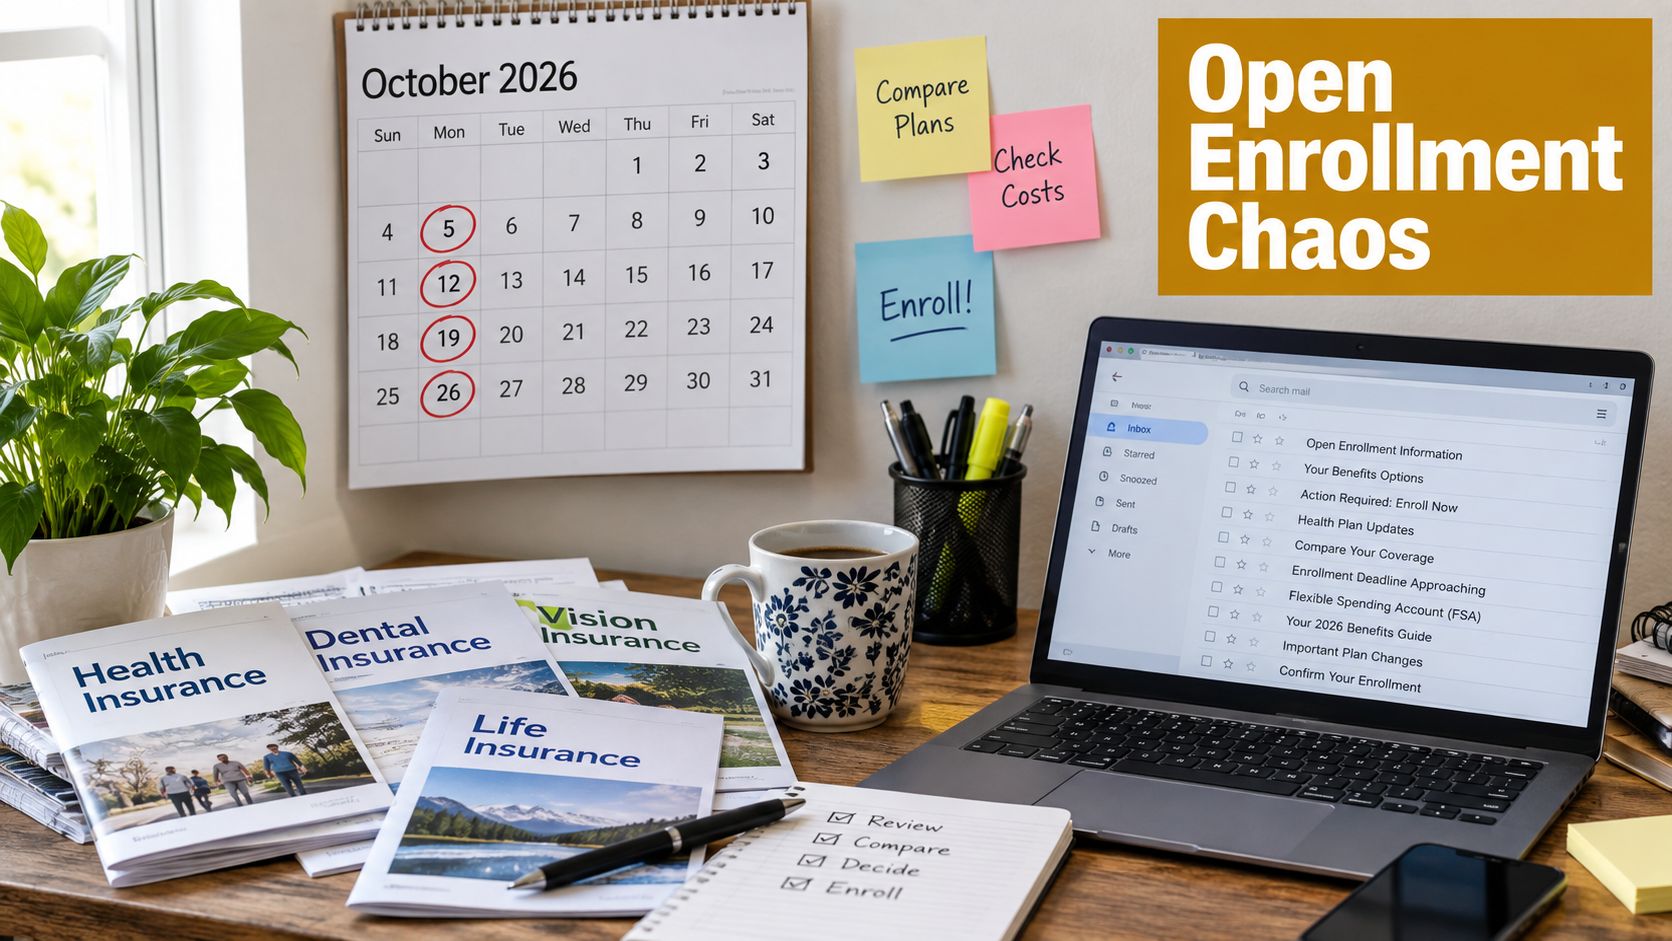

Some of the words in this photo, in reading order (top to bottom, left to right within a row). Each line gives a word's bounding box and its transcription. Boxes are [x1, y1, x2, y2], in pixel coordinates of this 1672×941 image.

[361, 64, 490, 99] October
[499, 61, 578, 93] 2026
[876, 80, 969, 107] Compare
[374, 128, 400, 142] Sun
[434, 125, 464, 139] Mon
[498, 122, 524, 136] Tue
[558, 118, 590, 133] Wed
[623, 117, 650, 130] Thu
[691, 114, 708, 128] Fri
[752, 112, 774, 126] Sat
[894, 112, 954, 138] Plans
[633, 157, 640, 174] 1
[694, 154, 706, 172] 2
[758, 152, 770, 169] 3
[993, 141, 1062, 173] Check
[1001, 180, 1064, 207] Costs
[381, 224, 394, 240] 4
[443, 220, 455, 237] 5
[506, 217, 518, 234] 6
[568, 214, 580, 231] 7
[631, 212, 643, 229] 8
[694, 209, 706, 226] 9
[752, 207, 775, 224] 10
[377, 279, 396, 296] 11
[438, 275, 461, 292] 12
[501, 272, 523, 289] 13
[563, 269, 586, 286] 14
[626, 266, 648, 283] 15
[688, 264, 711, 281] 16
[751, 262, 774, 279] 17
[880, 280, 971, 321] Enroll!
[377, 333, 399, 350] 18
[438, 329, 460, 347] 19
[499, 326, 524, 343] 20
[562, 323, 583, 340] 21
[624, 320, 648, 337] 22
[687, 318, 711, 335] 23
[750, 316, 774, 333] 24
[376, 388, 400, 405] 25
[436, 384, 461, 401] 26
[499, 380, 523, 397] 27
[562, 377, 586, 394] 28
[624, 374, 648, 391] 29
[686, 372, 711, 389] 30
[749, 371, 770, 387] 31
[1259, 383, 1289, 394] Search
[1292, 384, 1311, 397] mail
[1127, 423, 1151, 433] Inbox
[1123, 448, 1155, 459] Starred
[1306, 437, 1335, 450] Open
[1338, 440, 1396, 455] Enrollment
[1399, 445, 1462, 460] Information
[1119, 473, 1157, 485] Snoozed
[1304, 463, 1329, 474] Your
[1331, 465, 1376, 479] Benefits
[1380, 469, 1423, 483] Options
[1115, 498, 1135, 508] Sent
[1300, 489, 1335, 501] Action
[1339, 492, 1391, 507] Required:
[1395, 497, 1428, 510] Enroll
[1431, 501, 1458, 512] Now
[1111, 523, 1137, 534] Drafts
[1297, 514, 1334, 527] Health
[1337, 518, 1362, 530] Plan
[1366, 521, 1414, 535] Updates
[1108, 548, 1131, 559] More
[1294, 539, 1346, 554] Compare
[1350, 545, 1375, 557] Your
[1378, 549, 1434, 565] Coverage
[1291, 565, 1353, 581] Enrollment
[1356, 572, 1407, 587] Deadline
[1410, 578, 1485, 598] Approaching
[536, 605, 658, 632] Vision
[1288, 589, 1333, 604] Flexible
[1336, 596, 1391, 614] Spending
[1394, 602, 1443, 617] Account
[1447, 608, 1480, 624] (FSA)
[305, 615, 430, 650] Dental
[541, 627, 701, 653] Insurance
[1286, 615, 1311, 627] Your
[1314, 618, 1344, 631] 2026
[1347, 622, 1393, 637] Benefits
[1397, 628, 1432, 642] Guide
[316, 633, 492, 672] Insurance
[1282, 641, 1338, 656] Important
[1342, 647, 1367, 659] Plan
[1371, 652, 1422, 667] Changes
[71, 646, 206, 688] Health
[1279, 665, 1324, 680] Confirm
[1329, 671, 1355, 683] Your
[1358, 675, 1421, 693] Enrollment
[82, 667, 267, 714] Insurance
[471, 713, 548, 738] Life
[463, 736, 642, 769] Insurance
[867, 815, 943, 832] Review
[853, 837, 949, 856] Compare
[841, 858, 919, 875] Decide
[825, 881, 903, 899] Enroll
